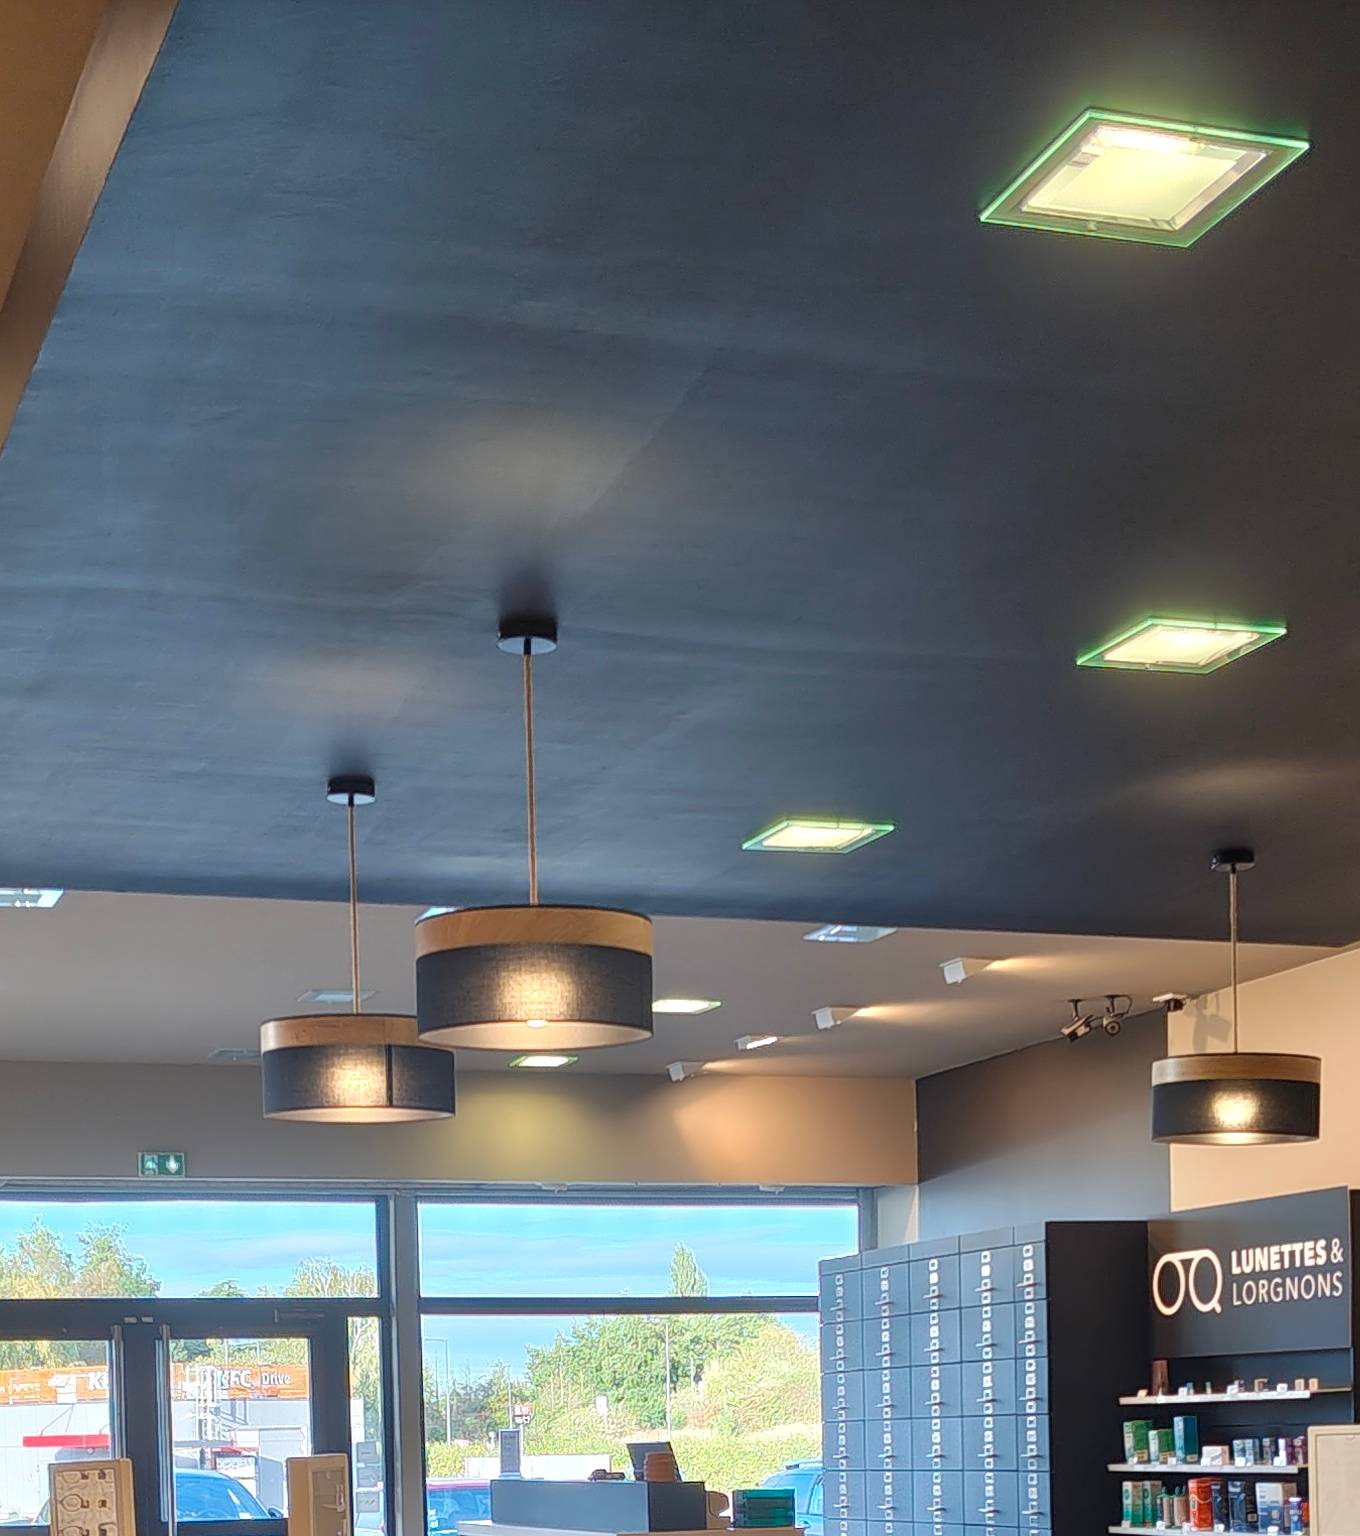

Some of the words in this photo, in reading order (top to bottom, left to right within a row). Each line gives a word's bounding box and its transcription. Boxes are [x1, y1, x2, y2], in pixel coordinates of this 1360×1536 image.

[1231, 1239, 1327, 1275] LUNETTES
[1330, 1237, 1344, 1263] &
[1232, 1270, 1343, 1306] LORGNONS
[262, 1372, 292, 1386] Drive
